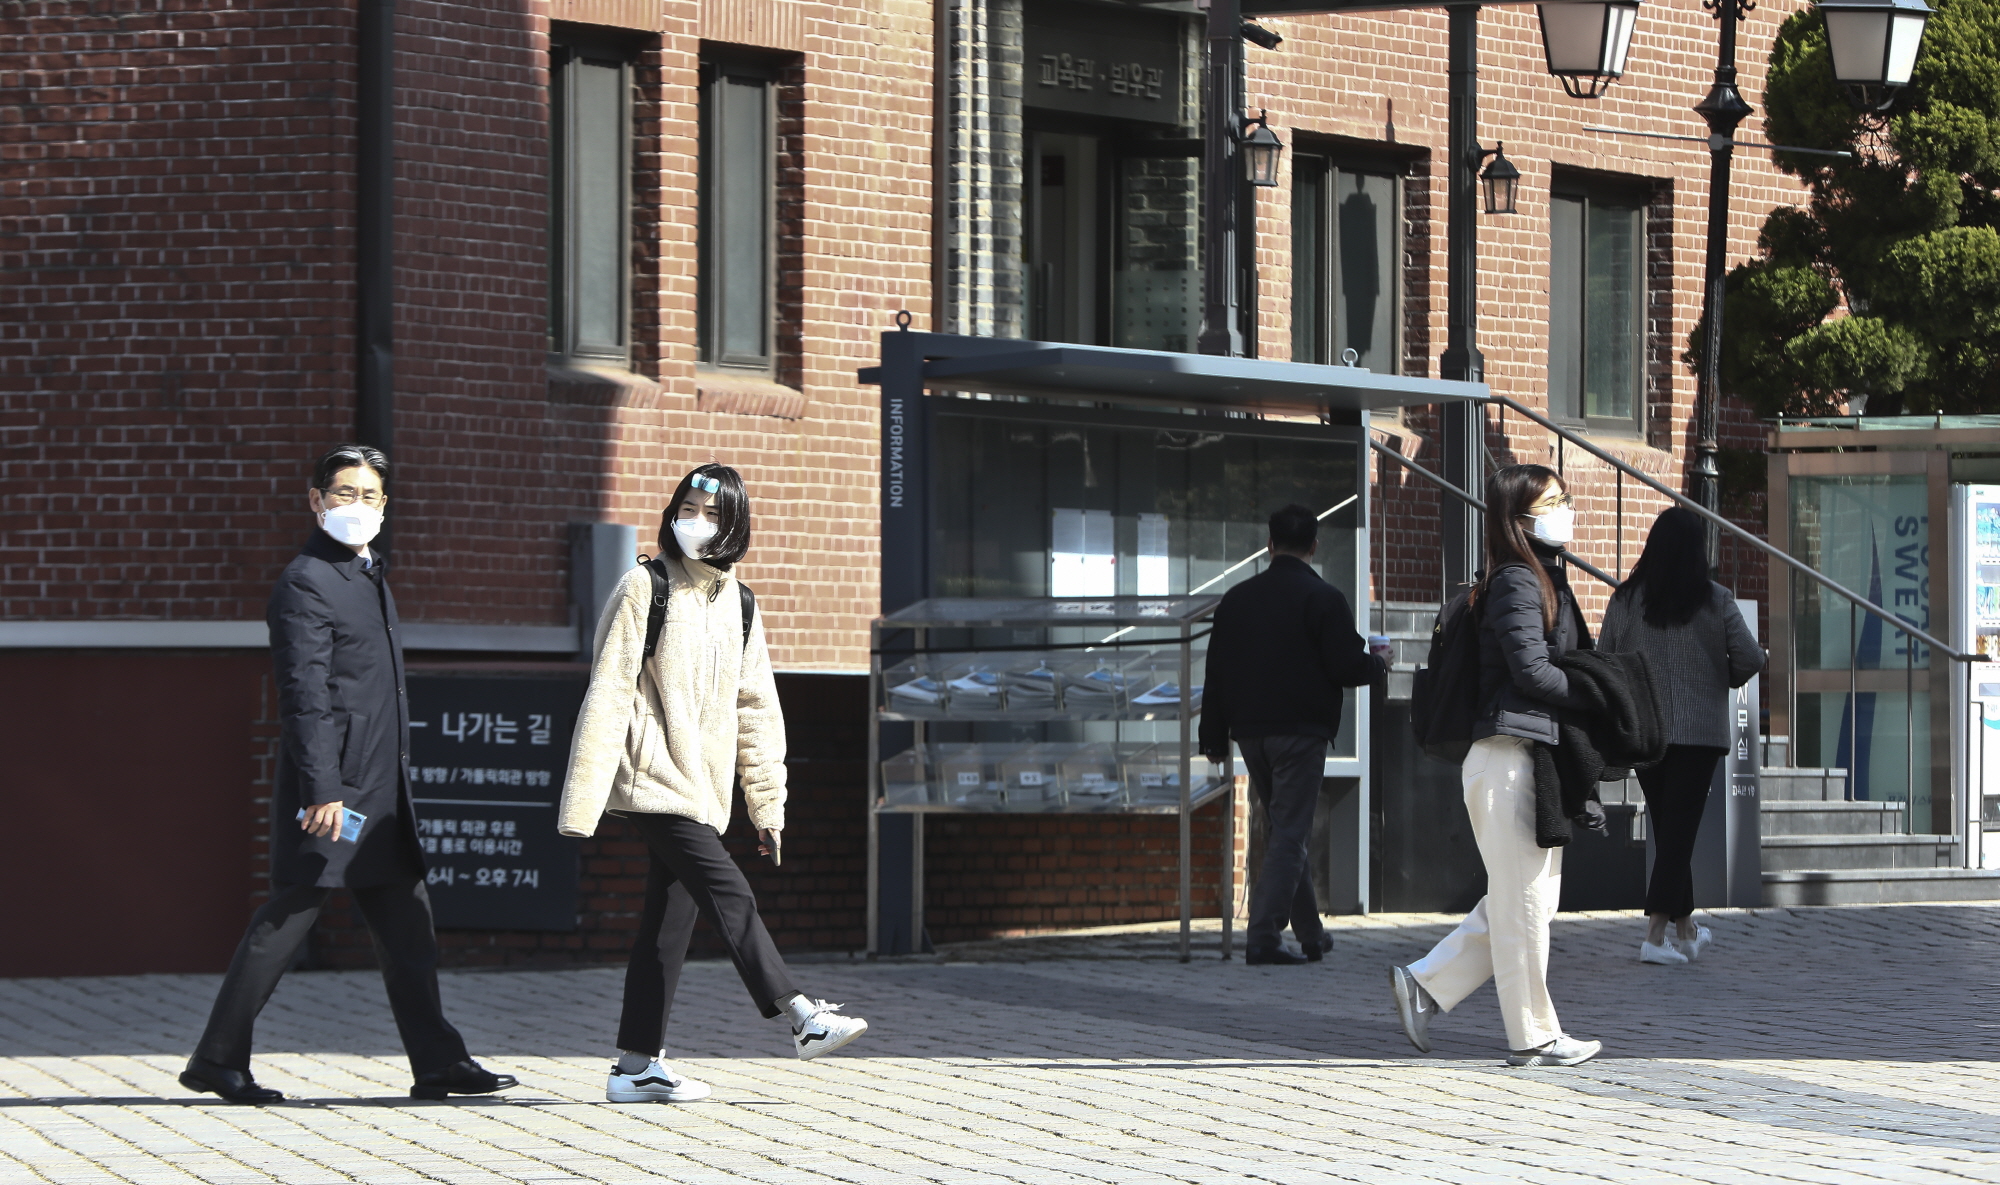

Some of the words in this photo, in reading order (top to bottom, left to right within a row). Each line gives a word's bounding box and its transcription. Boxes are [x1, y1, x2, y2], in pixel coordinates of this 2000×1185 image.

[1039, 53, 1095, 90] 교육관
[1111, 63, 1164, 99] 범우관
[889, 398, 904, 508] INFORMATION
[1894, 515, 1919, 663] SWEAT
[441, 712, 519, 745] 나가는
[527, 714, 551, 745] 길
[422, 766, 448, 784] 방향
[460, 767, 522, 786] 가톨릭회관
[525, 770, 551, 787] 방향
[418, 818, 458, 836] 가톨릭
[460, 820, 487, 837] 회관
[490, 820, 517, 837] 후문
[441, 837, 467, 855] 통로
[469, 838, 523, 856] 이용시간
[426, 866, 454, 886] 6시
[475, 867, 508, 888] 오후
[511, 869, 539, 888] 7시
